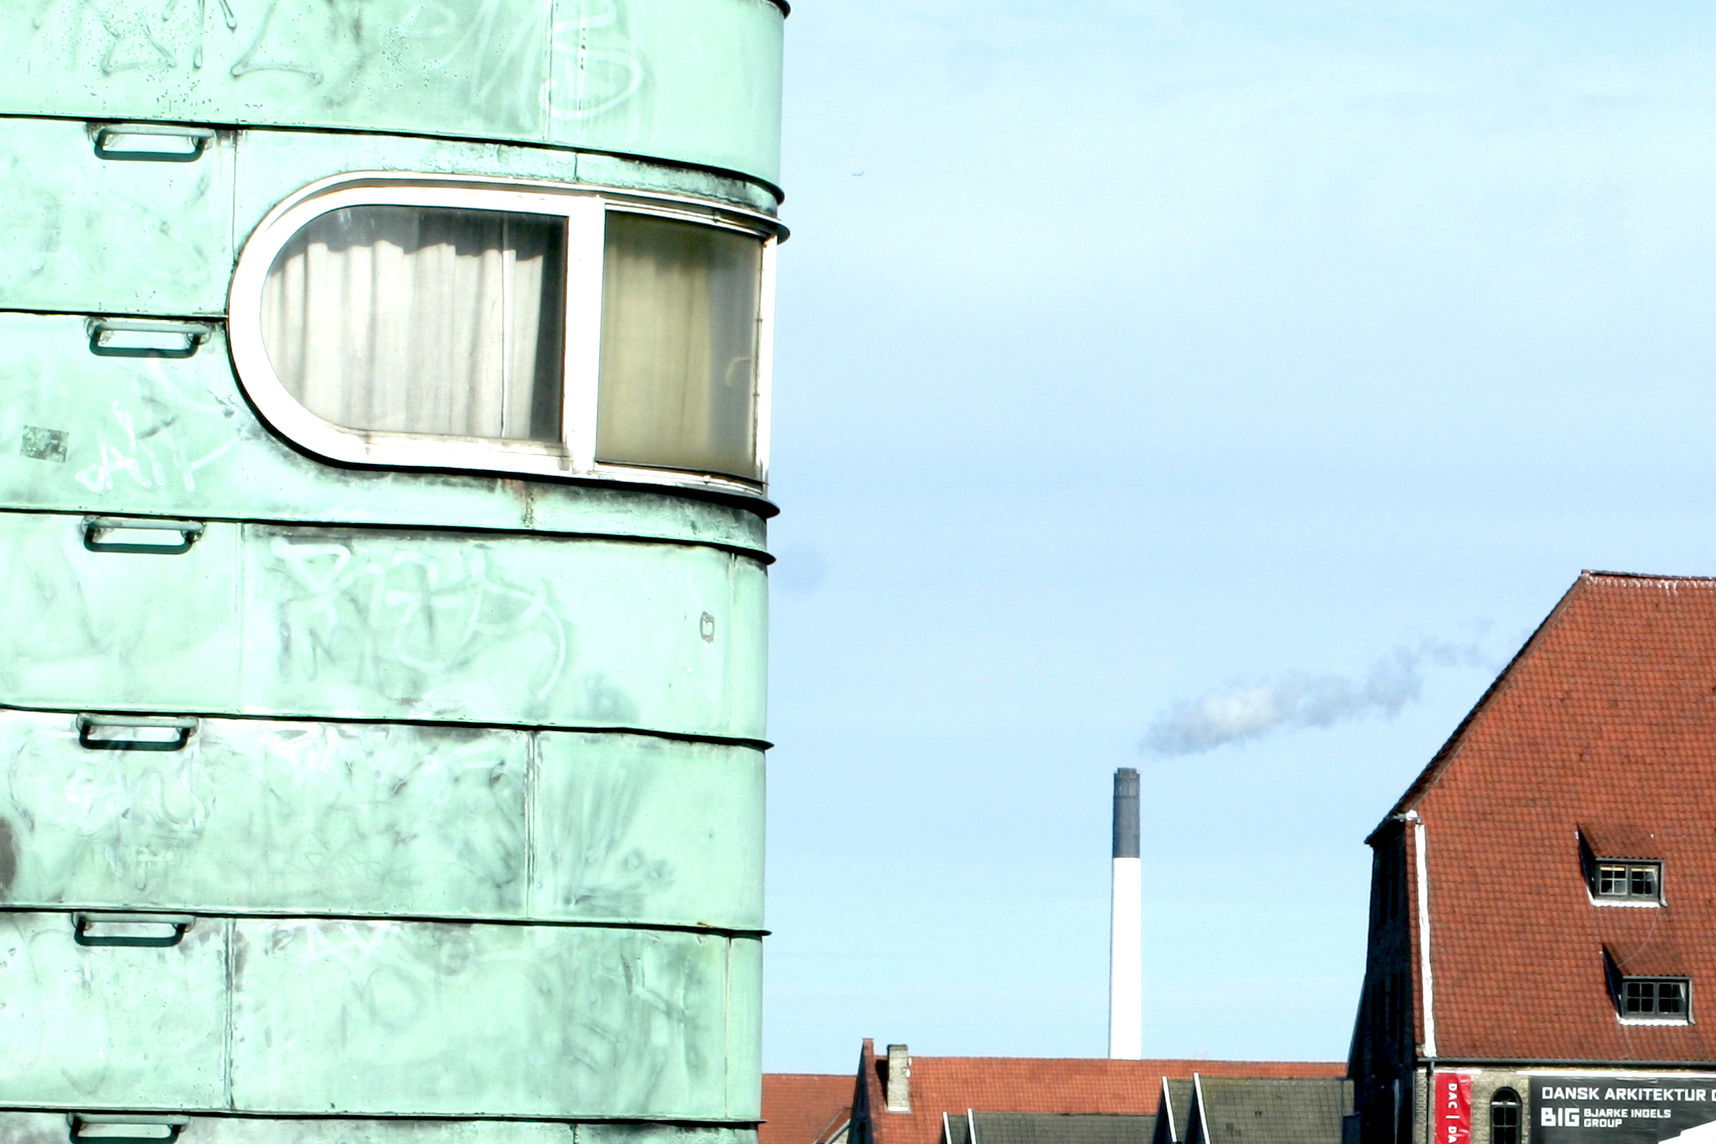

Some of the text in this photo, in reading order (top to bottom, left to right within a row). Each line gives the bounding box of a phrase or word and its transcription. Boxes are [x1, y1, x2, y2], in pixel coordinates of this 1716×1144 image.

[1447, 1083, 1458, 1109] DAC
[1541, 1087, 1600, 1100] DANSK
[1604, 1088, 1707, 1101] ARKITEKTUR
[1541, 1107, 1671, 1127] BIG BJARKE INGELS
[1584, 1119, 1623, 1128] GROUP
